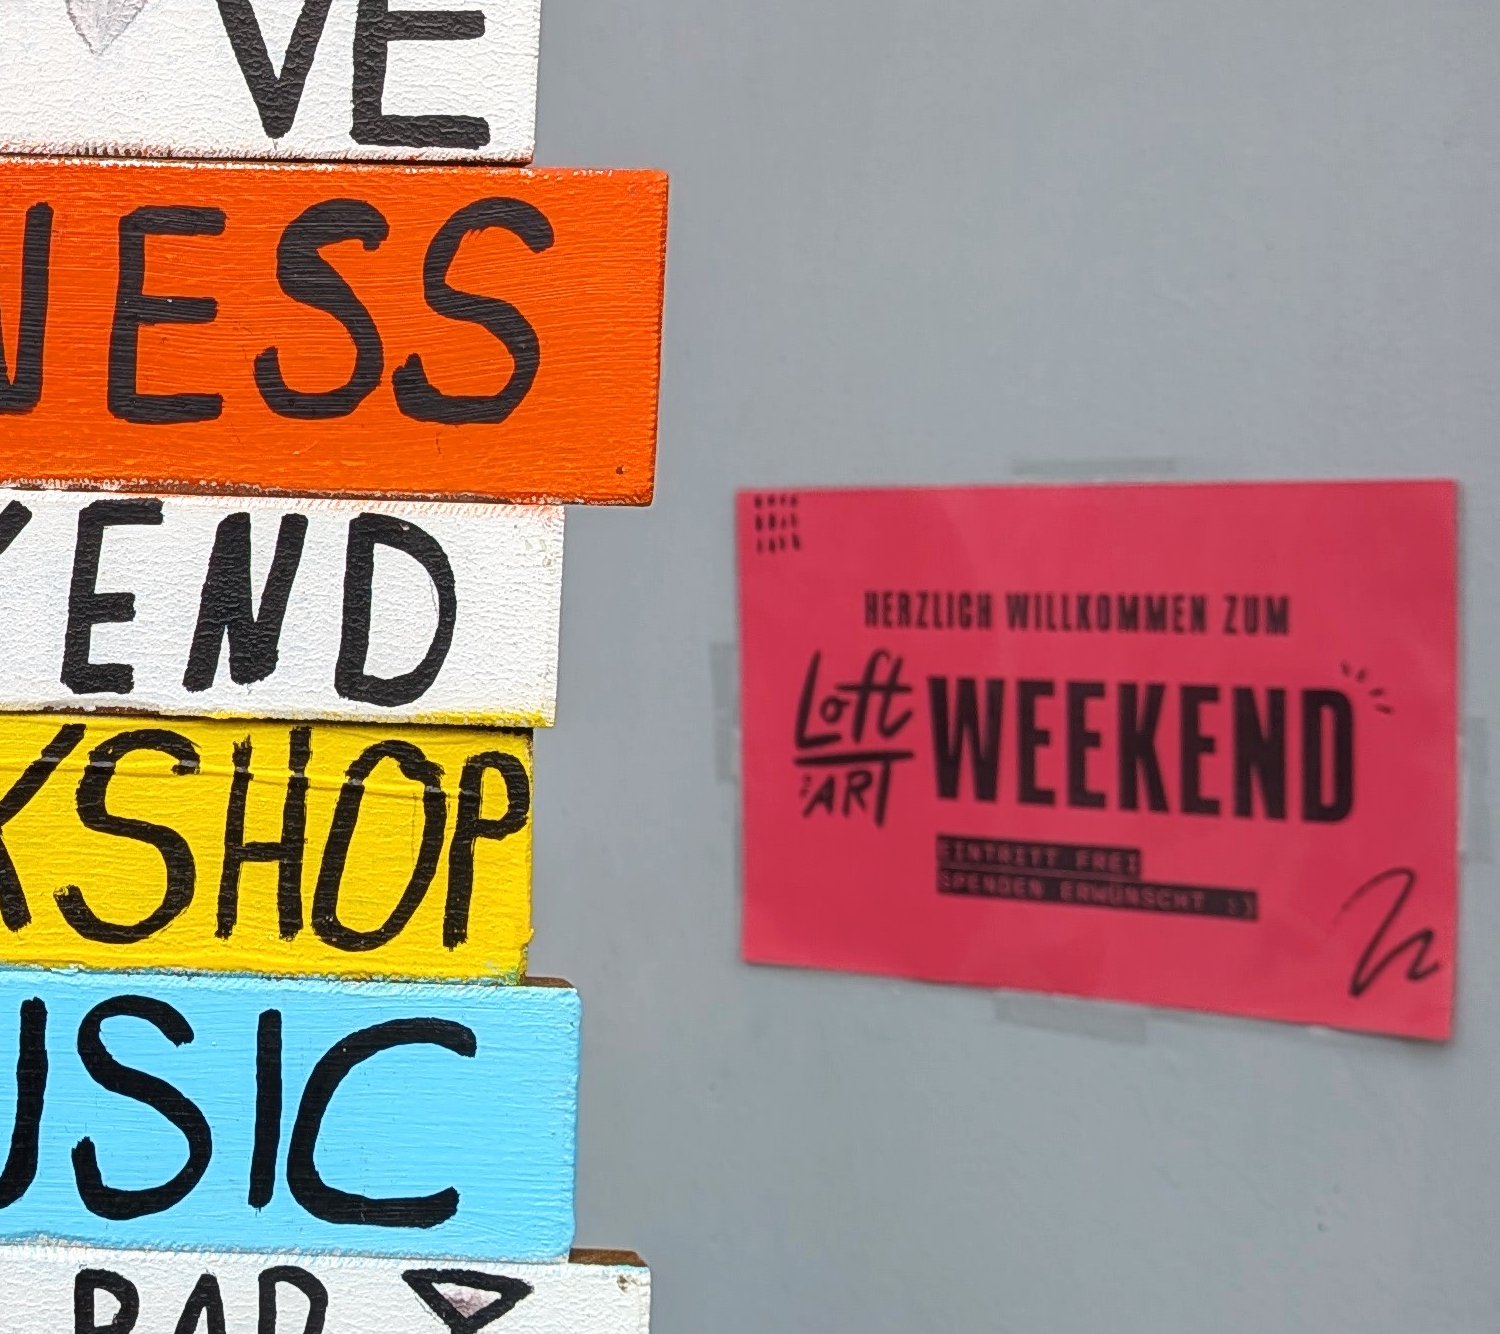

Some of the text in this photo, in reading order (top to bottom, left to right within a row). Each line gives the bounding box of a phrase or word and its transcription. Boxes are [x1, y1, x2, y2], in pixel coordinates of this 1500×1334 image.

[864, 591, 1290, 635] HERZLICH WILLKOMMEN ZUM
[795, 648, 913, 749] Loft
[802, 751, 912, 828] ART
[927, 674, 1355, 823] WEEKEND
